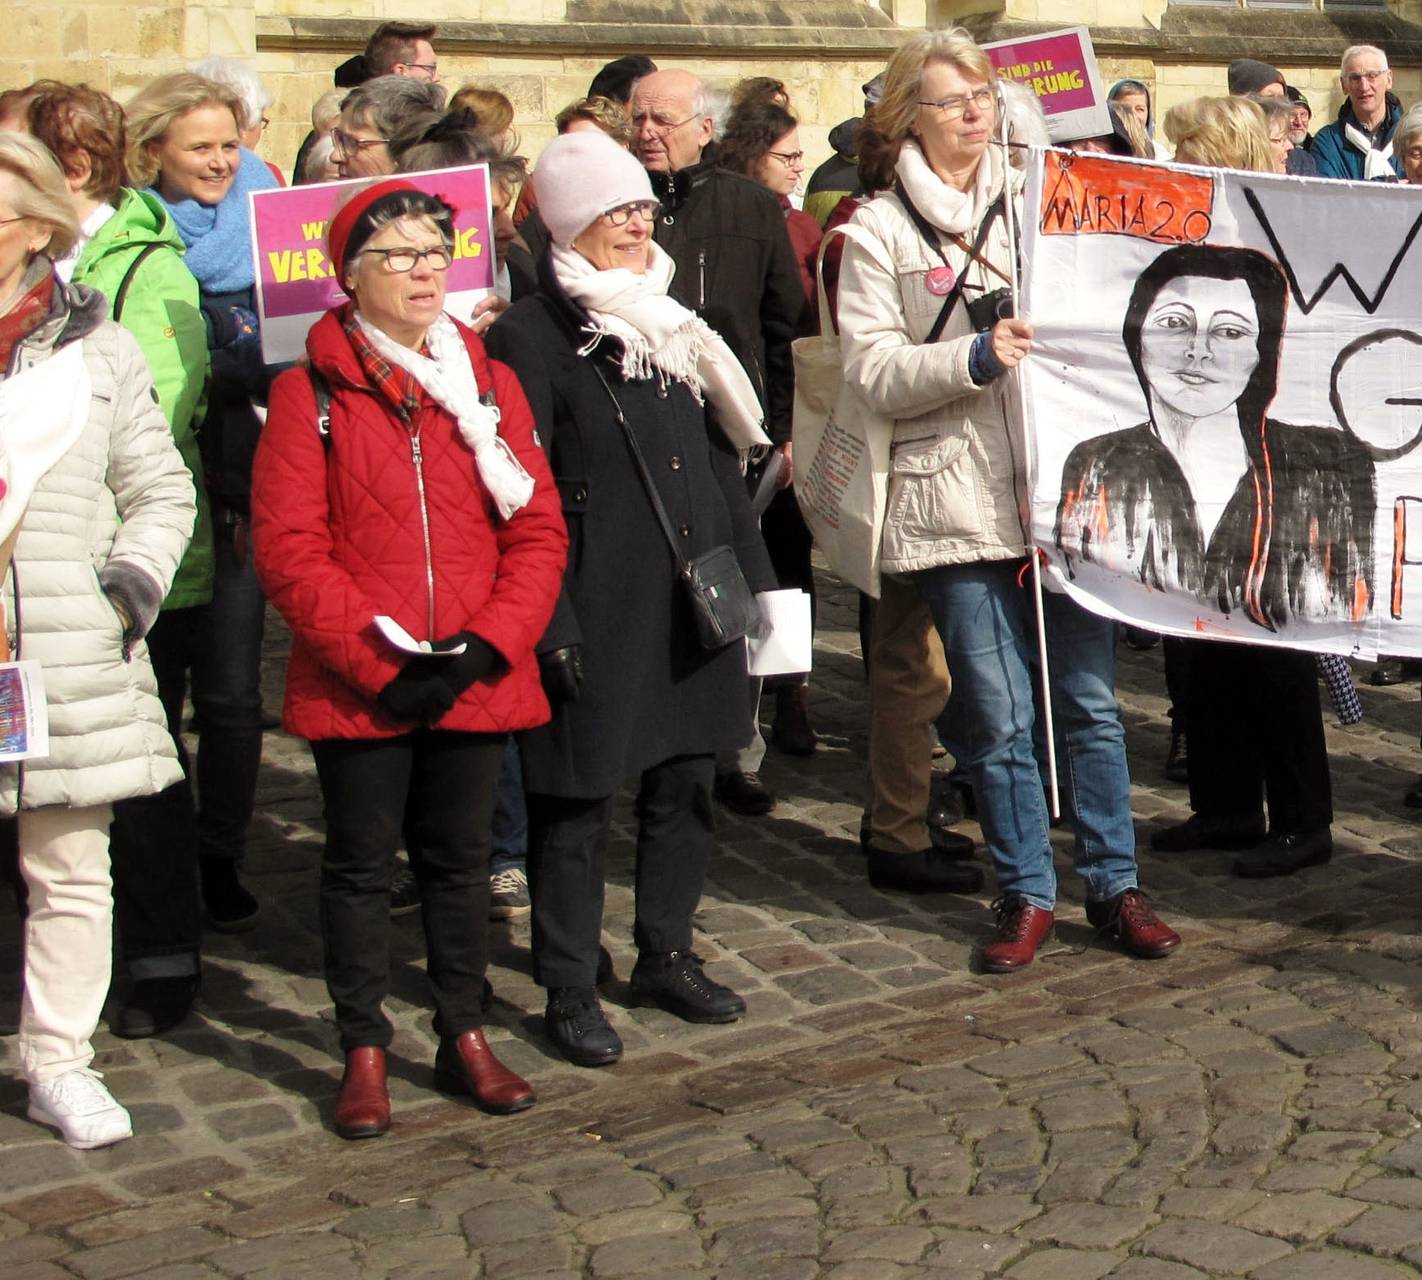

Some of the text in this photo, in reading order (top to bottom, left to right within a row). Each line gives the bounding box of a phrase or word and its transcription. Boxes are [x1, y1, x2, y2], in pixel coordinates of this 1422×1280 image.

[997, 60, 1054, 79] SIND DIE
[1026, 70, 1084, 96] RUNG
[1042, 188, 1211, 242] MARIA 2.0
